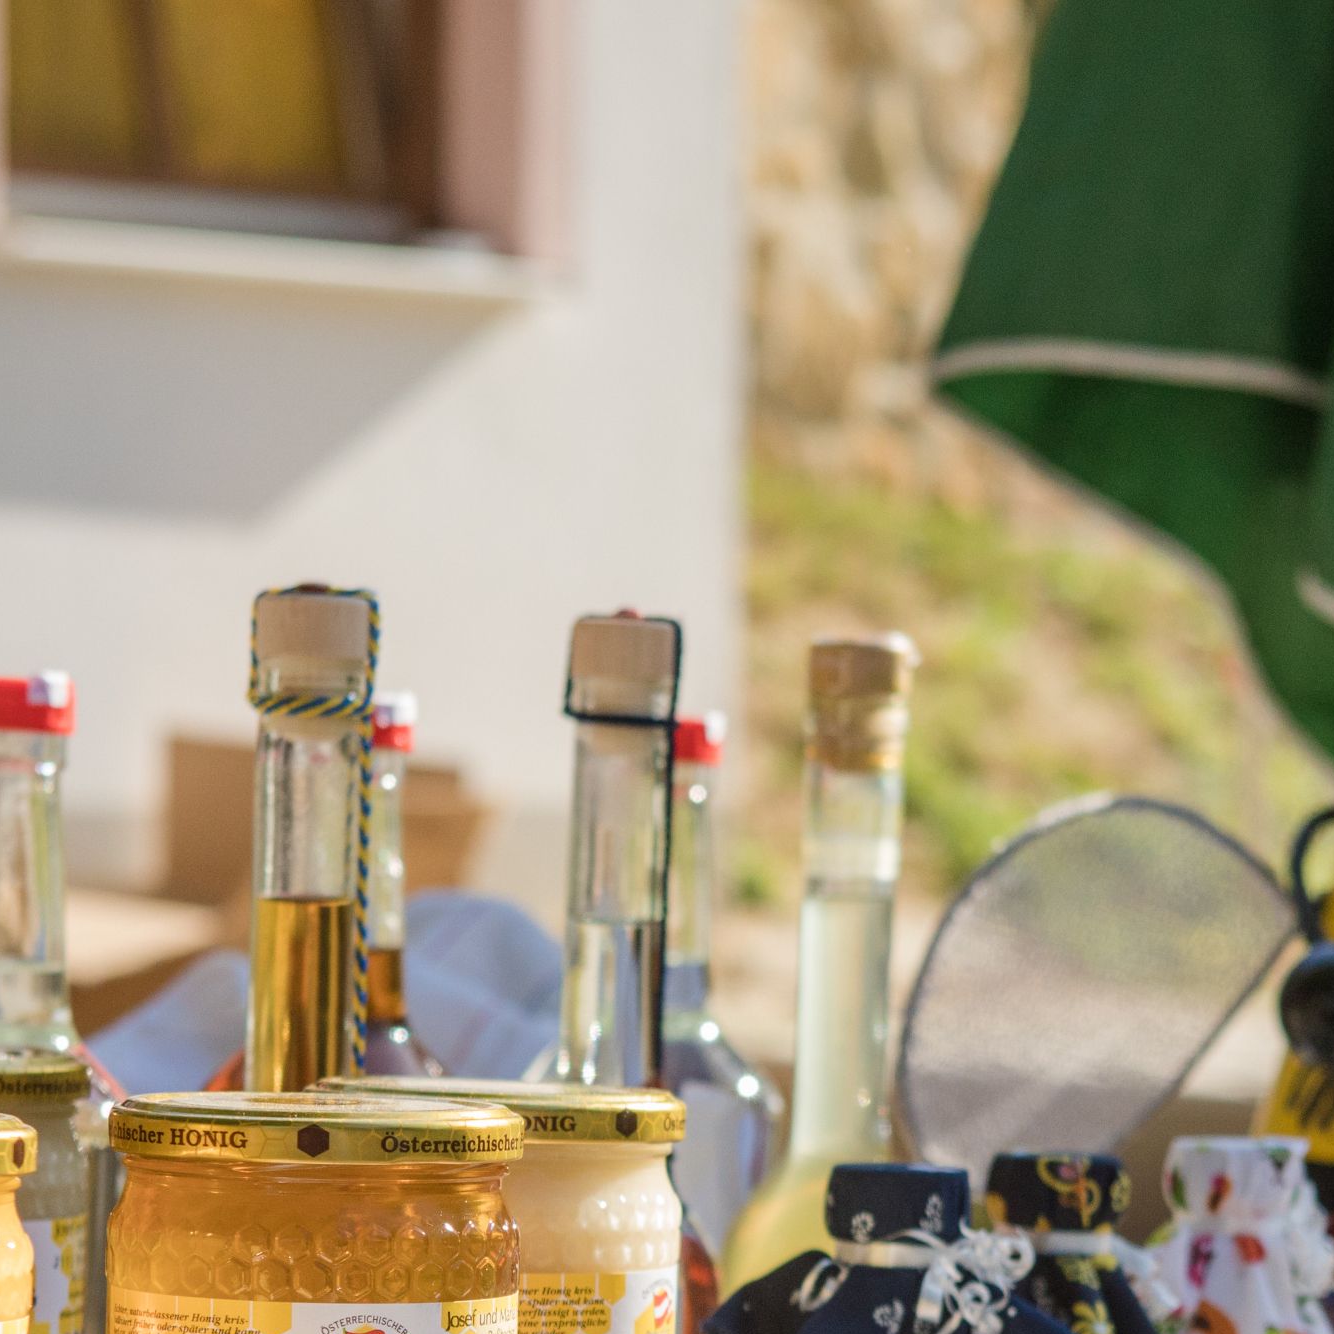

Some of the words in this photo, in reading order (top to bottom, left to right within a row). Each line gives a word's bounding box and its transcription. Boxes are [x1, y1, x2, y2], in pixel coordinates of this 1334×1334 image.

[169, 1128, 249, 1149] HONIG
[380, 1130, 518, 1155] Österreichischer
[157, 1323, 178, 1332] oder
[191, 1313, 221, 1326] Honig
[224, 1314, 249, 1325] kris-
[445, 1308, 478, 1332] Josef
[479, 1307, 498, 1326] und
